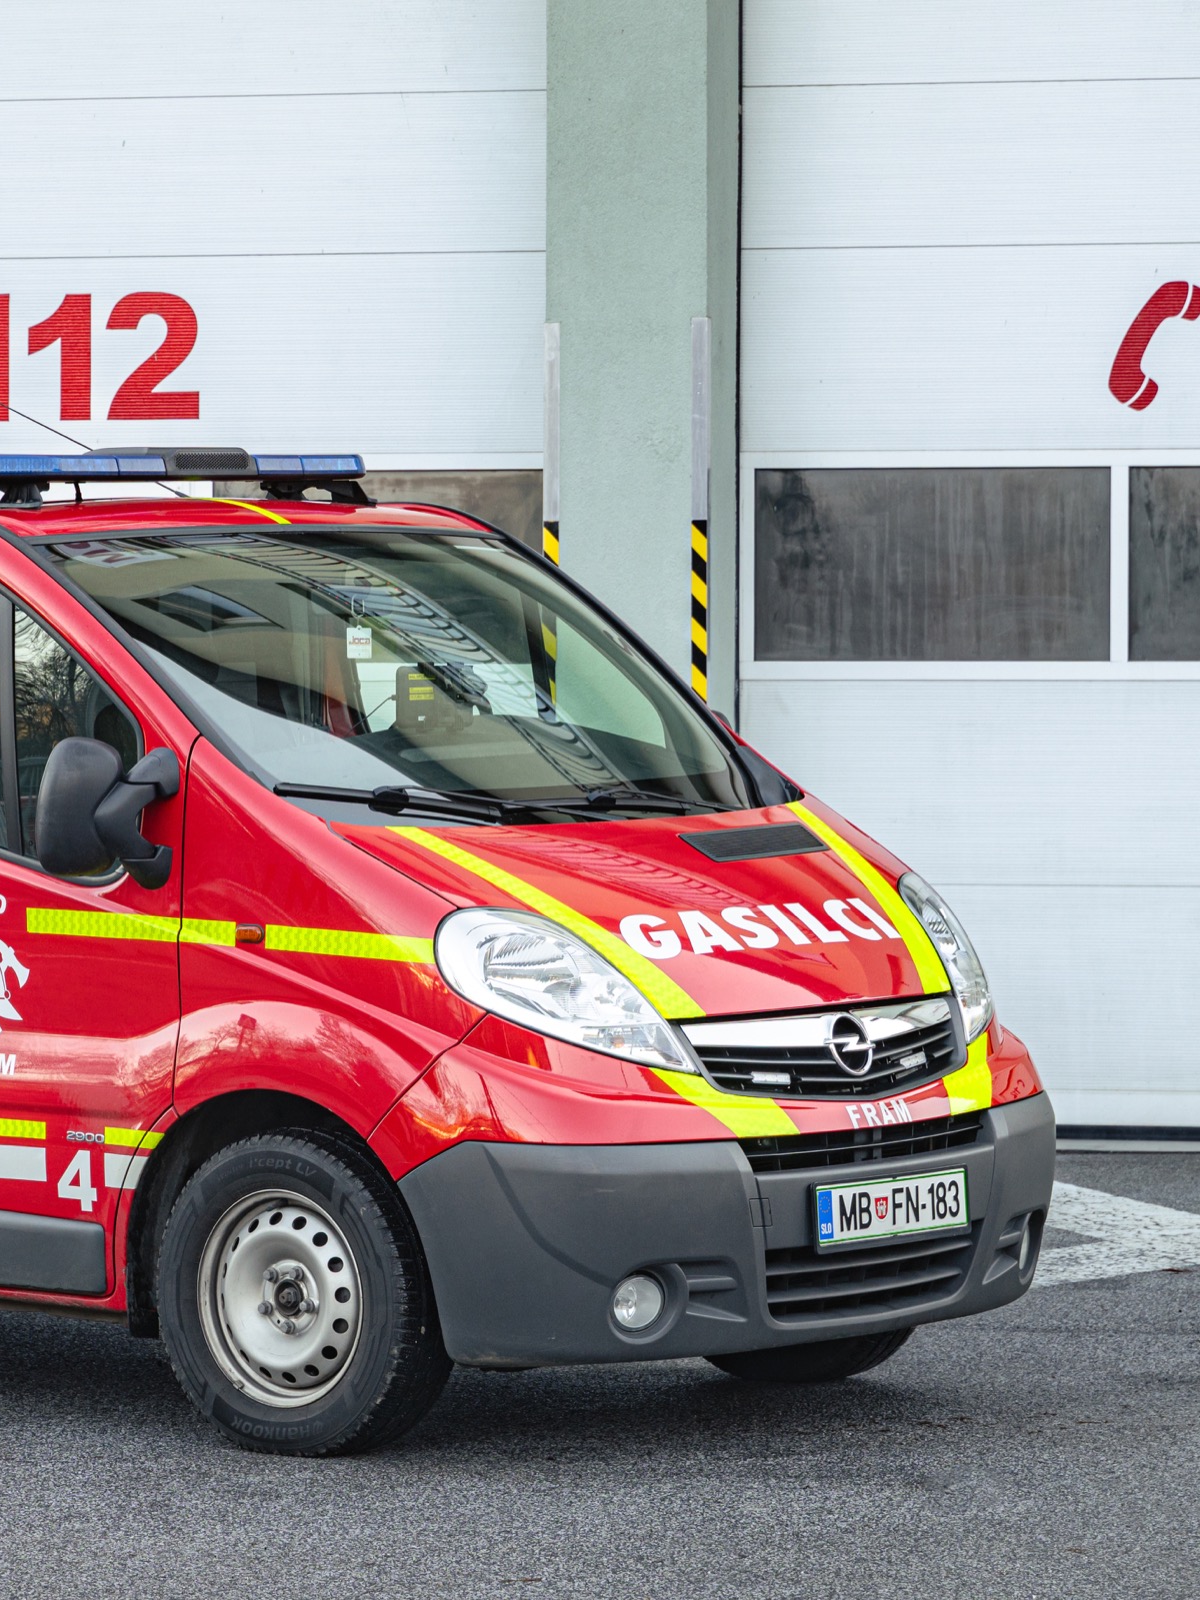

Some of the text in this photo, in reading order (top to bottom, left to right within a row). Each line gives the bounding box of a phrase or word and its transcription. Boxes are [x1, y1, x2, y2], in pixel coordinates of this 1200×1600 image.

[618, 897, 904, 960] GASILCI
[845, 1098, 913, 1130] FRAM
[66, 1130, 105, 1144] 2900
[57, 1149, 98, 1212] 4
[838, 1179, 961, 1233] MB FN-183
[820, 1222, 833, 1235] SLO
